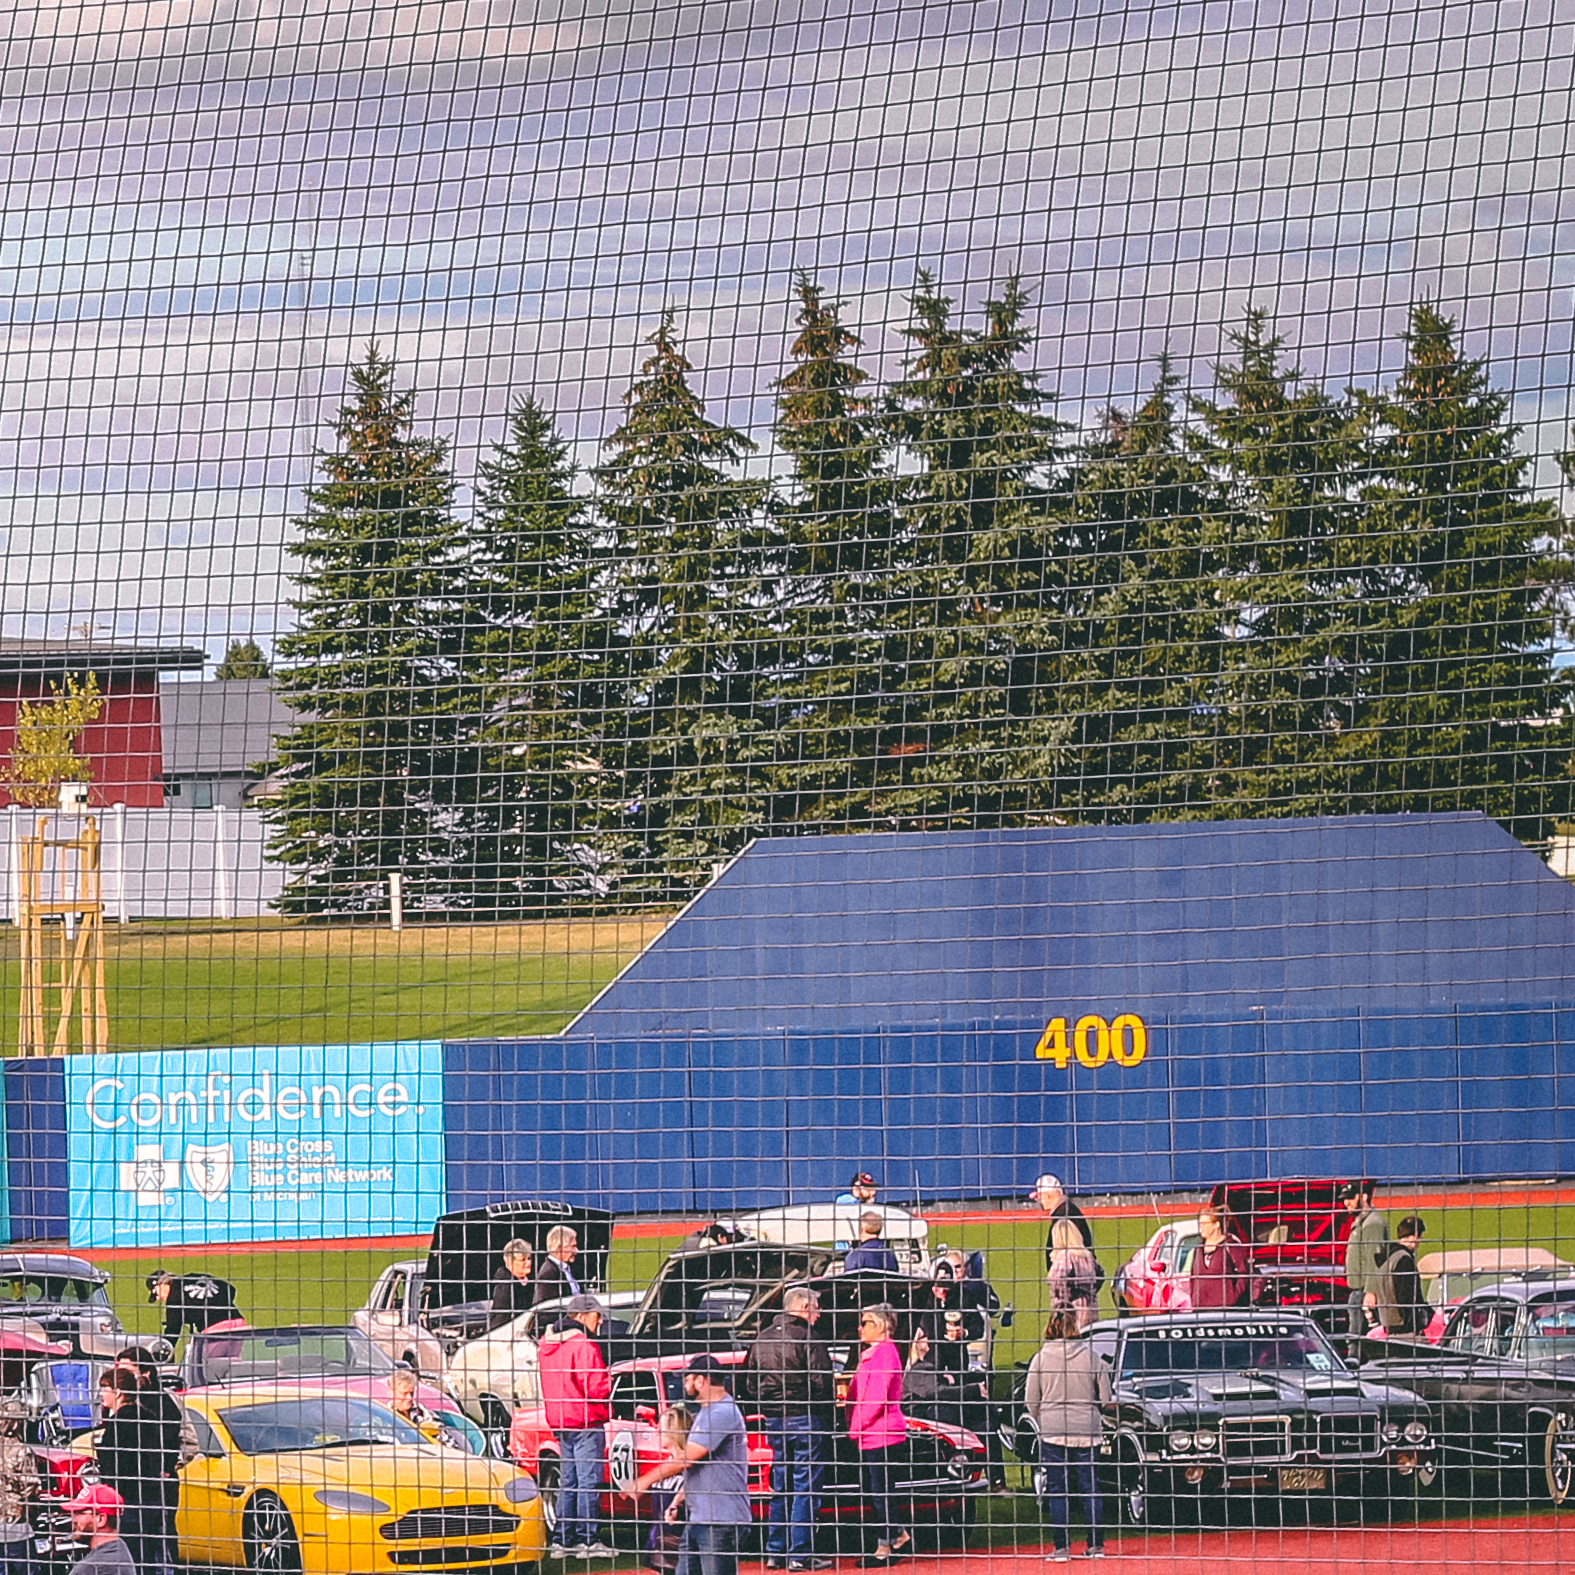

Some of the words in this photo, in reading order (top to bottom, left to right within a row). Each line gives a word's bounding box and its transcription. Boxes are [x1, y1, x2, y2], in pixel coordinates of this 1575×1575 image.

[1034, 1013, 1148, 1069] 400
[85, 1069, 426, 1129] Confidence.
[247, 1140, 282, 1155] Blue
[286, 1138, 333, 1154] Cross
[248, 1154, 283, 1169] Blue
[286, 1152, 336, 1168] Shield
[249, 1168, 284, 1187] Blue
[286, 1168, 324, 1186] Care
[327, 1165, 394, 1184] Network
[262, 1190, 316, 1204] Michigan
